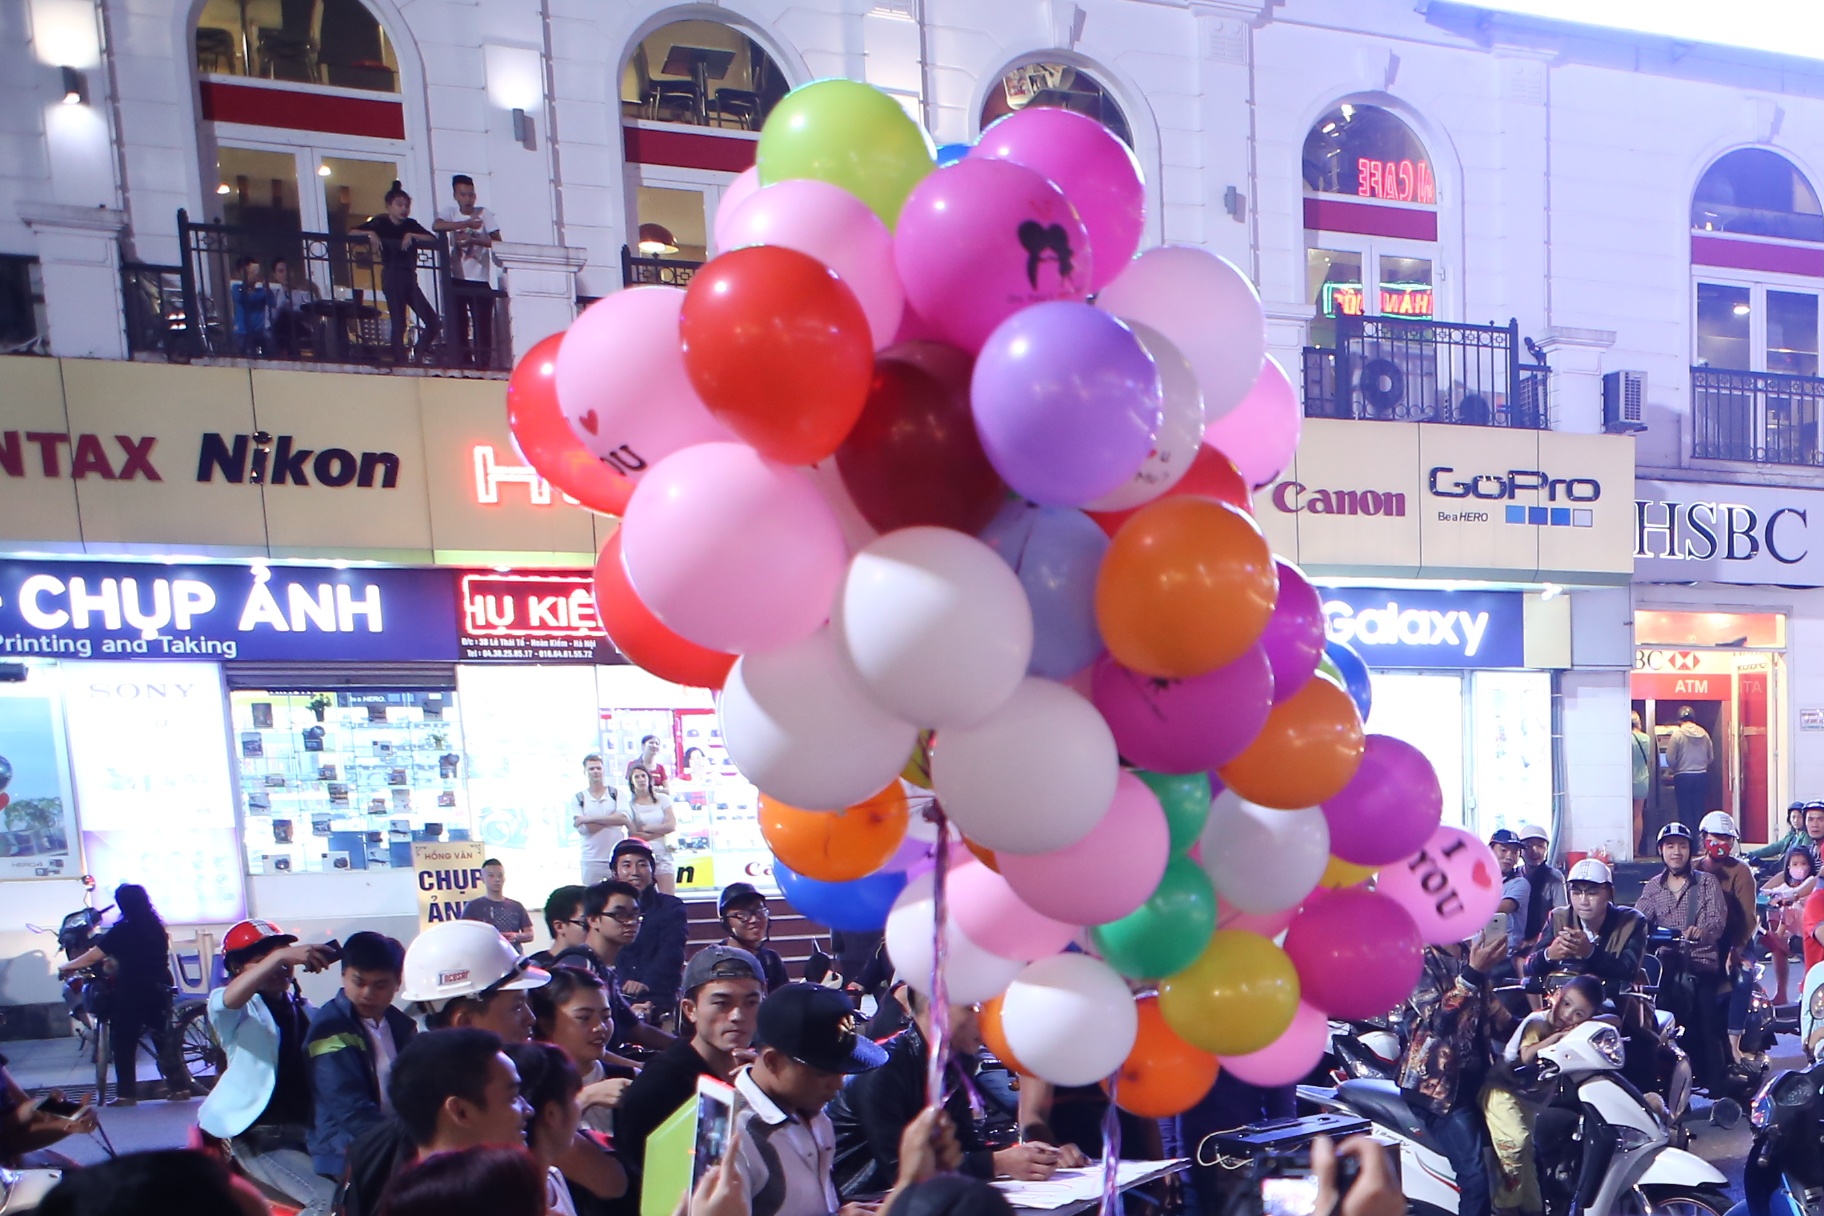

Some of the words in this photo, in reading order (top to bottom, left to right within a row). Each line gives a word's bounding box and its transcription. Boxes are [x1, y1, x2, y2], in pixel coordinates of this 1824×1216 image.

[196, 431, 399, 488] Nikon
[1273, 481, 1405, 516] Canon
[1429, 467, 1600, 502] GoPro
[1459, 511, 1488, 522] HERO
[1633, 500, 1808, 564] HSBC
[19, 574, 216, 641] CHỤP
[239, 563, 383, 633] ẢNH
[1323, 600, 1489, 656] Galaxy
[102, 637, 148, 654] and
[160, 635, 237, 659] Taking
[89, 683, 194, 699] SONY
[1675, 680, 1708, 693] ATM
[1441, 838, 1466, 859] I
[418, 868, 483, 894] CHỤP
[1407, 849, 1465, 918] YOU
[428, 895, 468, 924] ẢN
